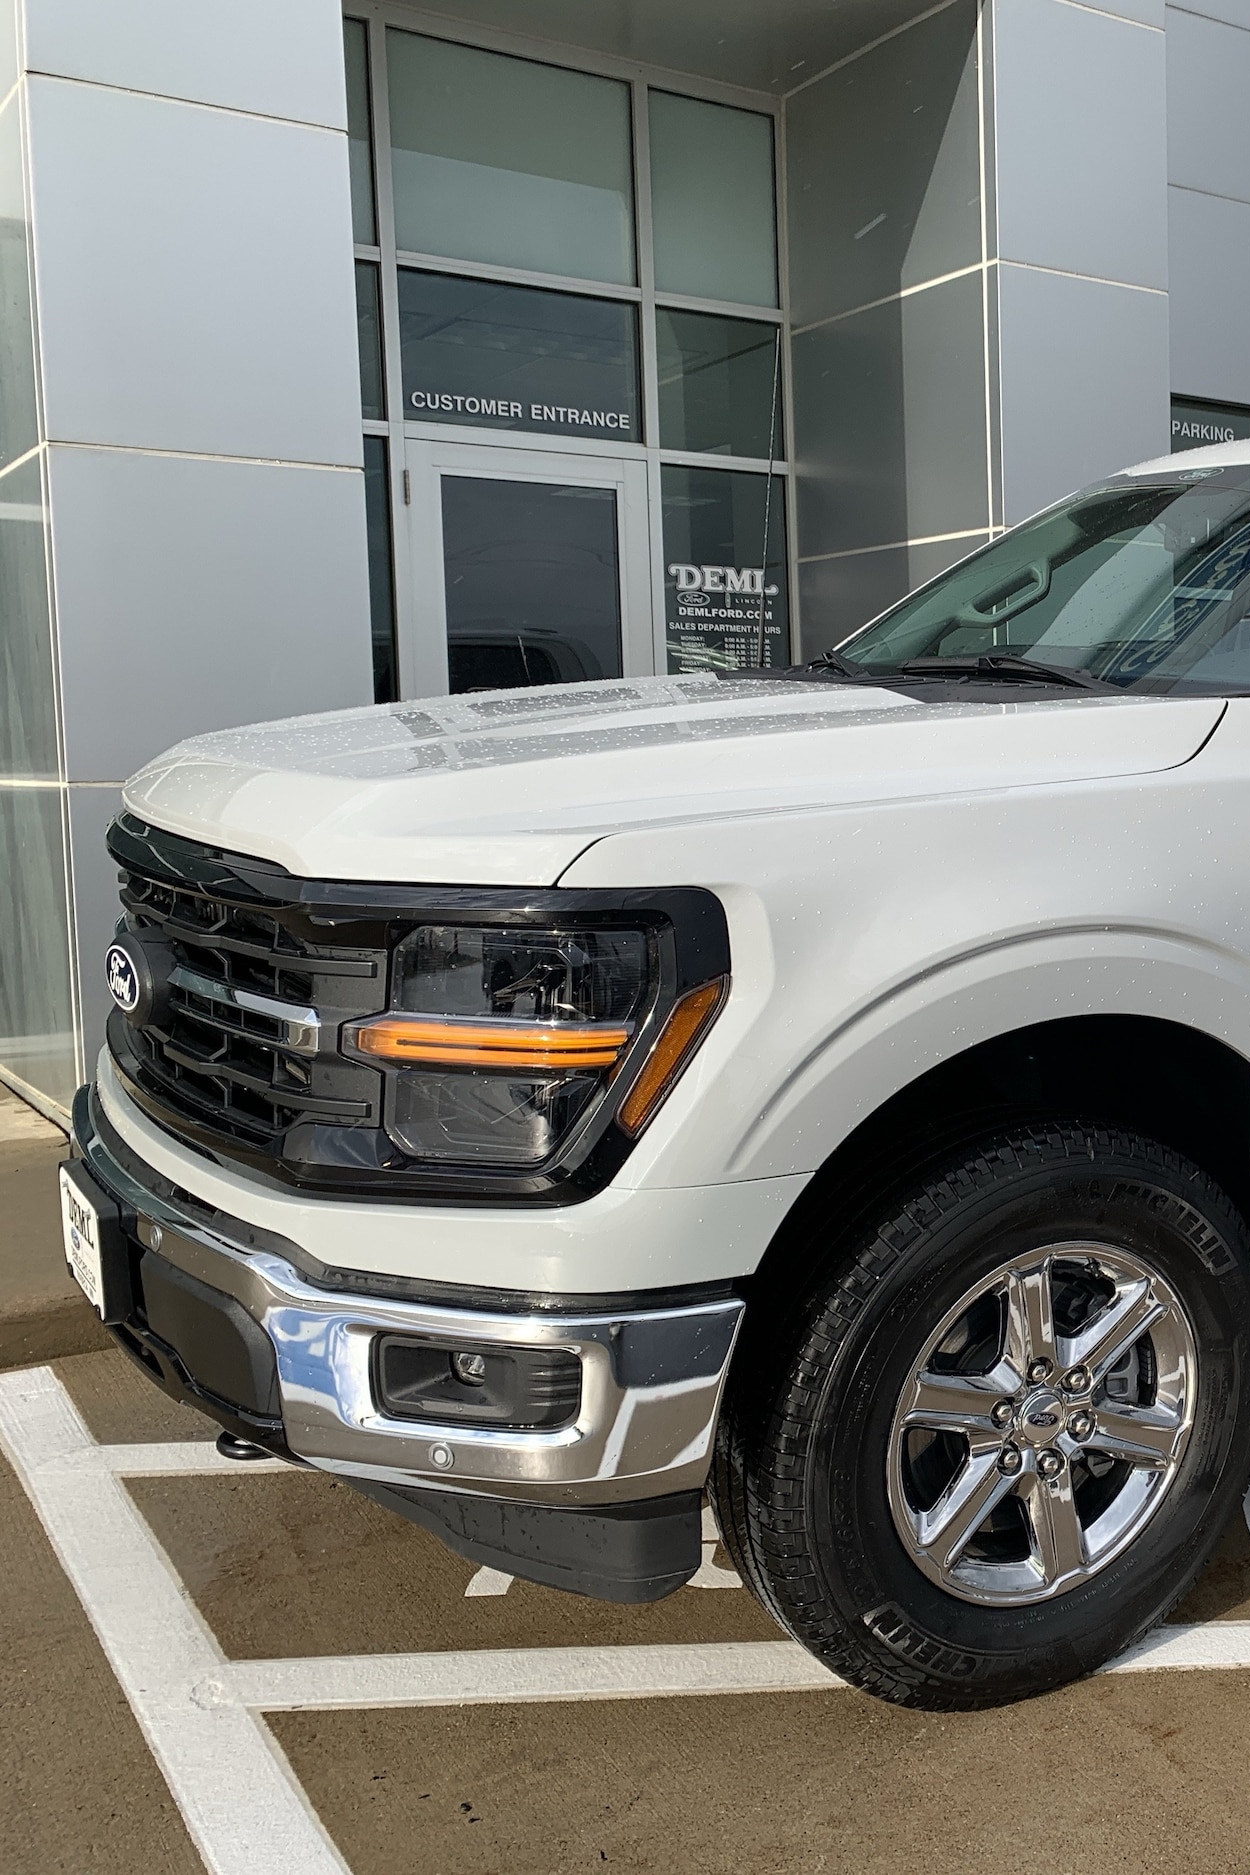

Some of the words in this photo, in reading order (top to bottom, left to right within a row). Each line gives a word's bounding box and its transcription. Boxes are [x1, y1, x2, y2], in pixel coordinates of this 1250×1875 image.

[411, 391, 523, 418] CUSTOMER
[531, 404, 631, 430] ENTRANCE
[1172, 420, 1235, 442] PARKING
[668, 563, 779, 596] DEML
[735, 597, 773, 606] LINCON
[669, 622, 697, 632] SALES
[698, 623, 752, 634] DEPARTMENT
[753, 625, 781, 635] HURS
[109, 952, 132, 1003] Ford
[1032, 1414, 1056, 1426] Ford
